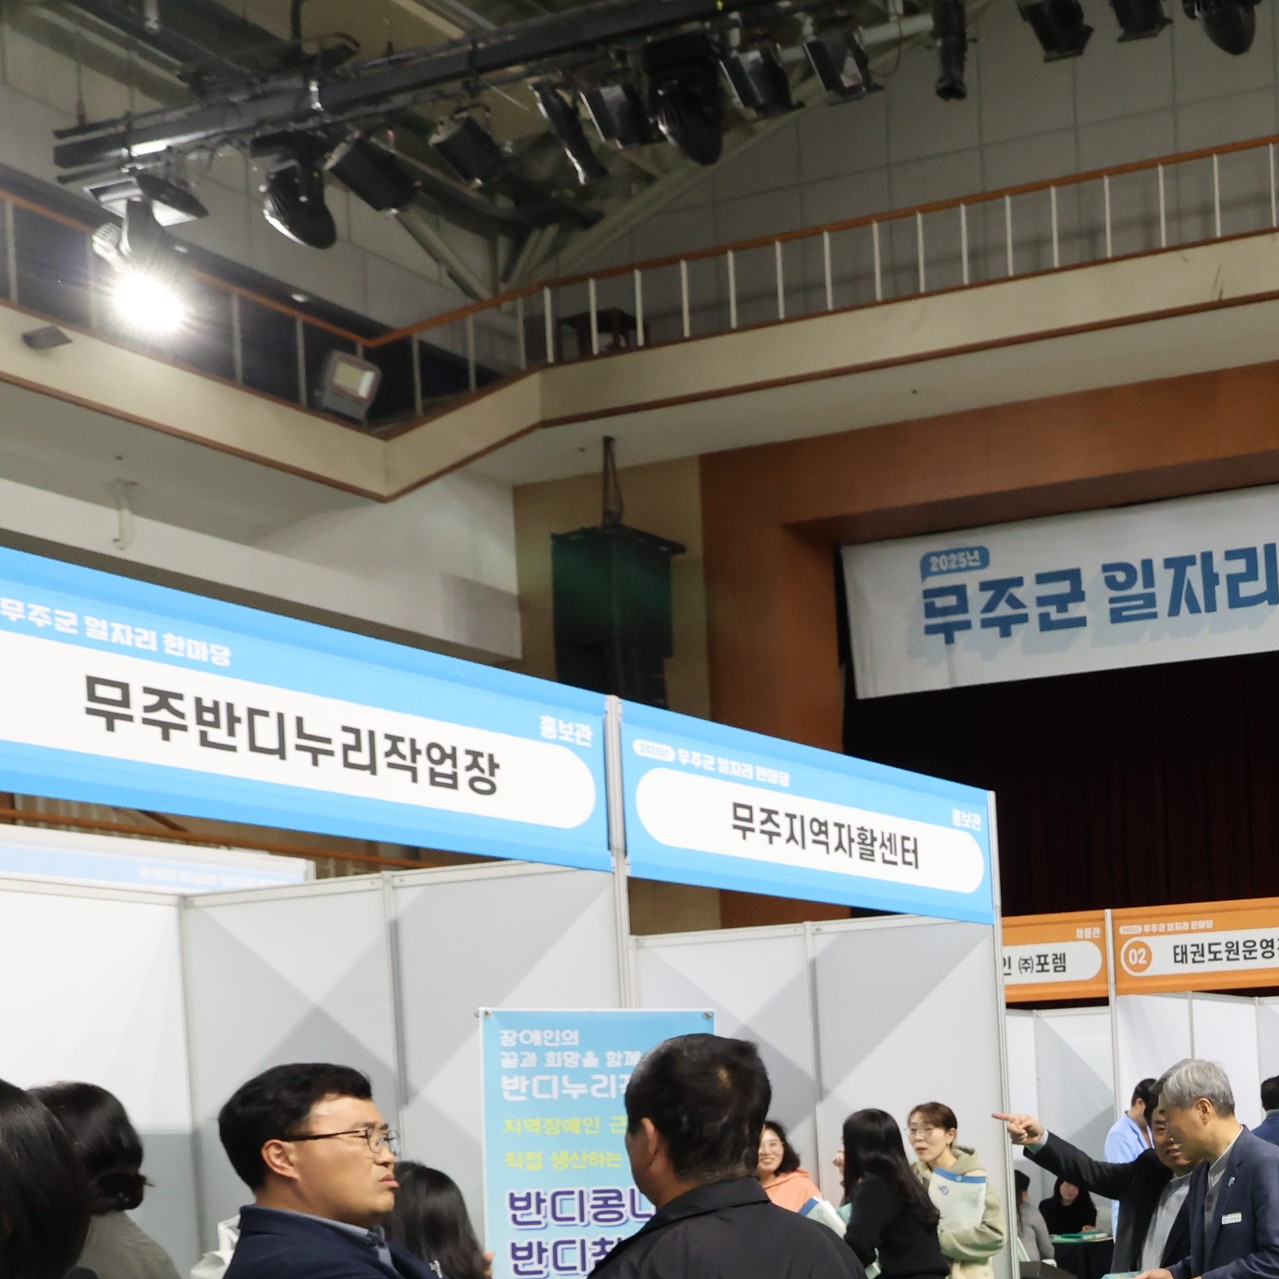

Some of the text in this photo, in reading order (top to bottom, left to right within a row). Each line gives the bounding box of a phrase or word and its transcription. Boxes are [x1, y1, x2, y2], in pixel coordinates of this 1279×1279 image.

[929, 550, 981, 572] 2025년
[922, 568, 1087, 645] 무주군
[1101, 542, 1279, 624] 일자리
[0, 597, 231, 667] 무주군 일자리 한마당
[85, 675, 500, 796] 무주반디누리작업장
[539, 715, 593, 747] 홍보관
[951, 808, 982, 832] 홍보관
[732, 801, 919, 869] 무주지역자활센터
[1128, 948, 1147, 966] 02
[499, 1029, 579, 1046] 장애인의
[544, 1051, 599, 1068] 희망을
[504, 1152, 543, 1170] 직접
